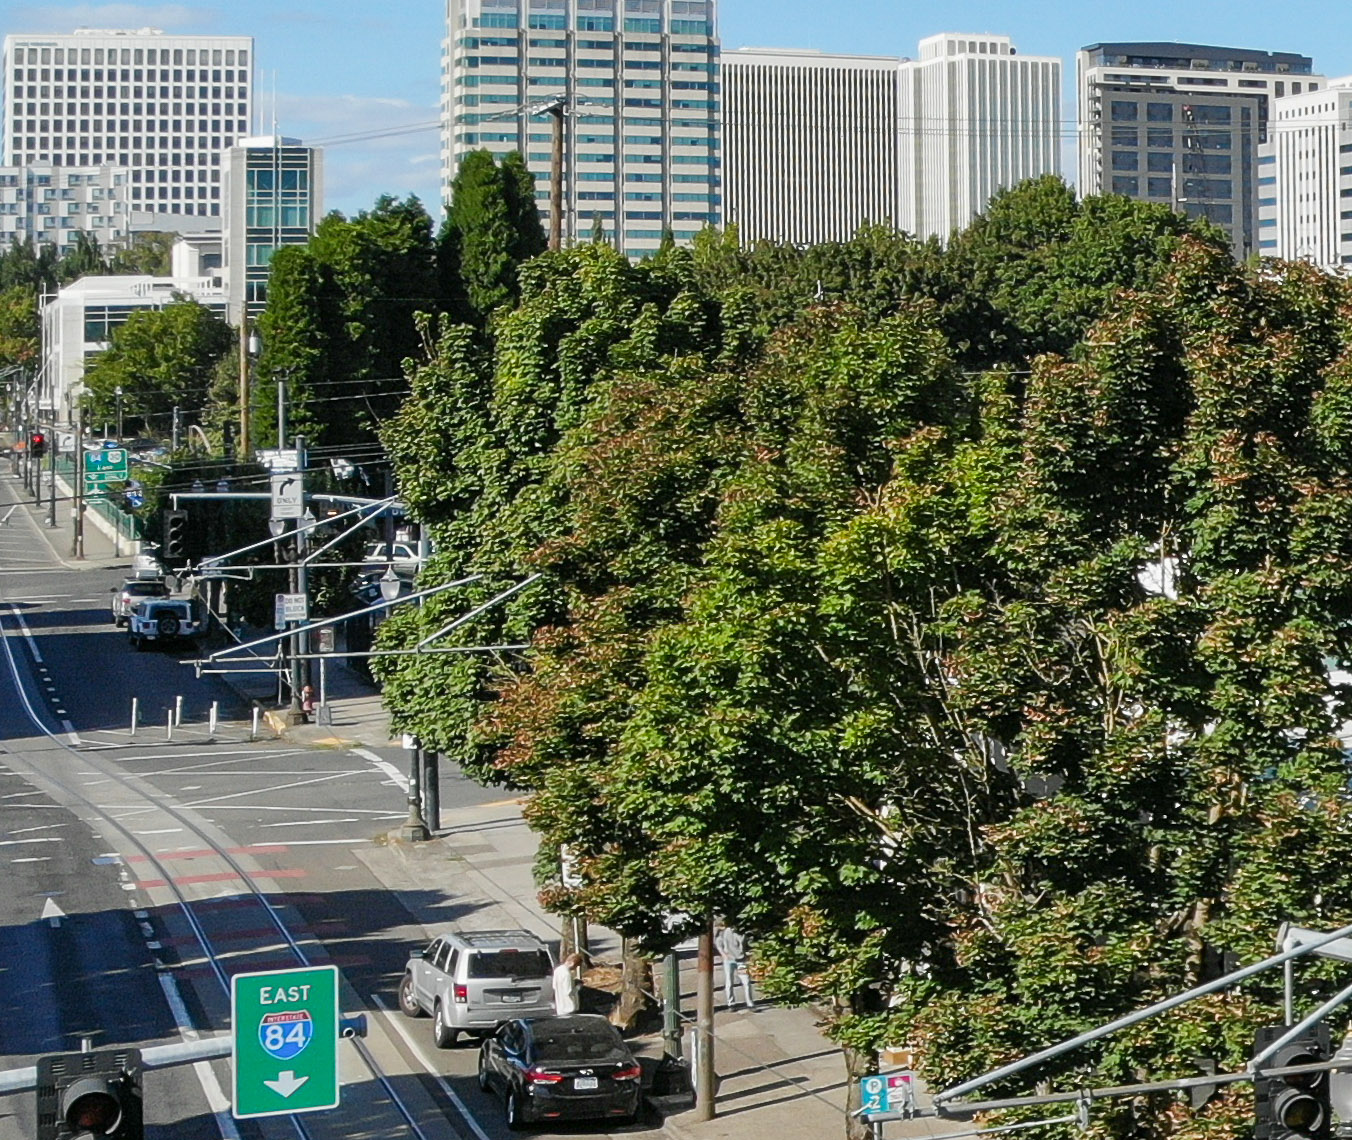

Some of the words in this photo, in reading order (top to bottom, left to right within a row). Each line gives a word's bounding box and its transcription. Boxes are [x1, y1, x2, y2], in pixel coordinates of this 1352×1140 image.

[259, 984, 311, 1005] EAST
[267, 1013, 305, 1023] INTERSTATE
[264, 1022, 307, 1051] 84
